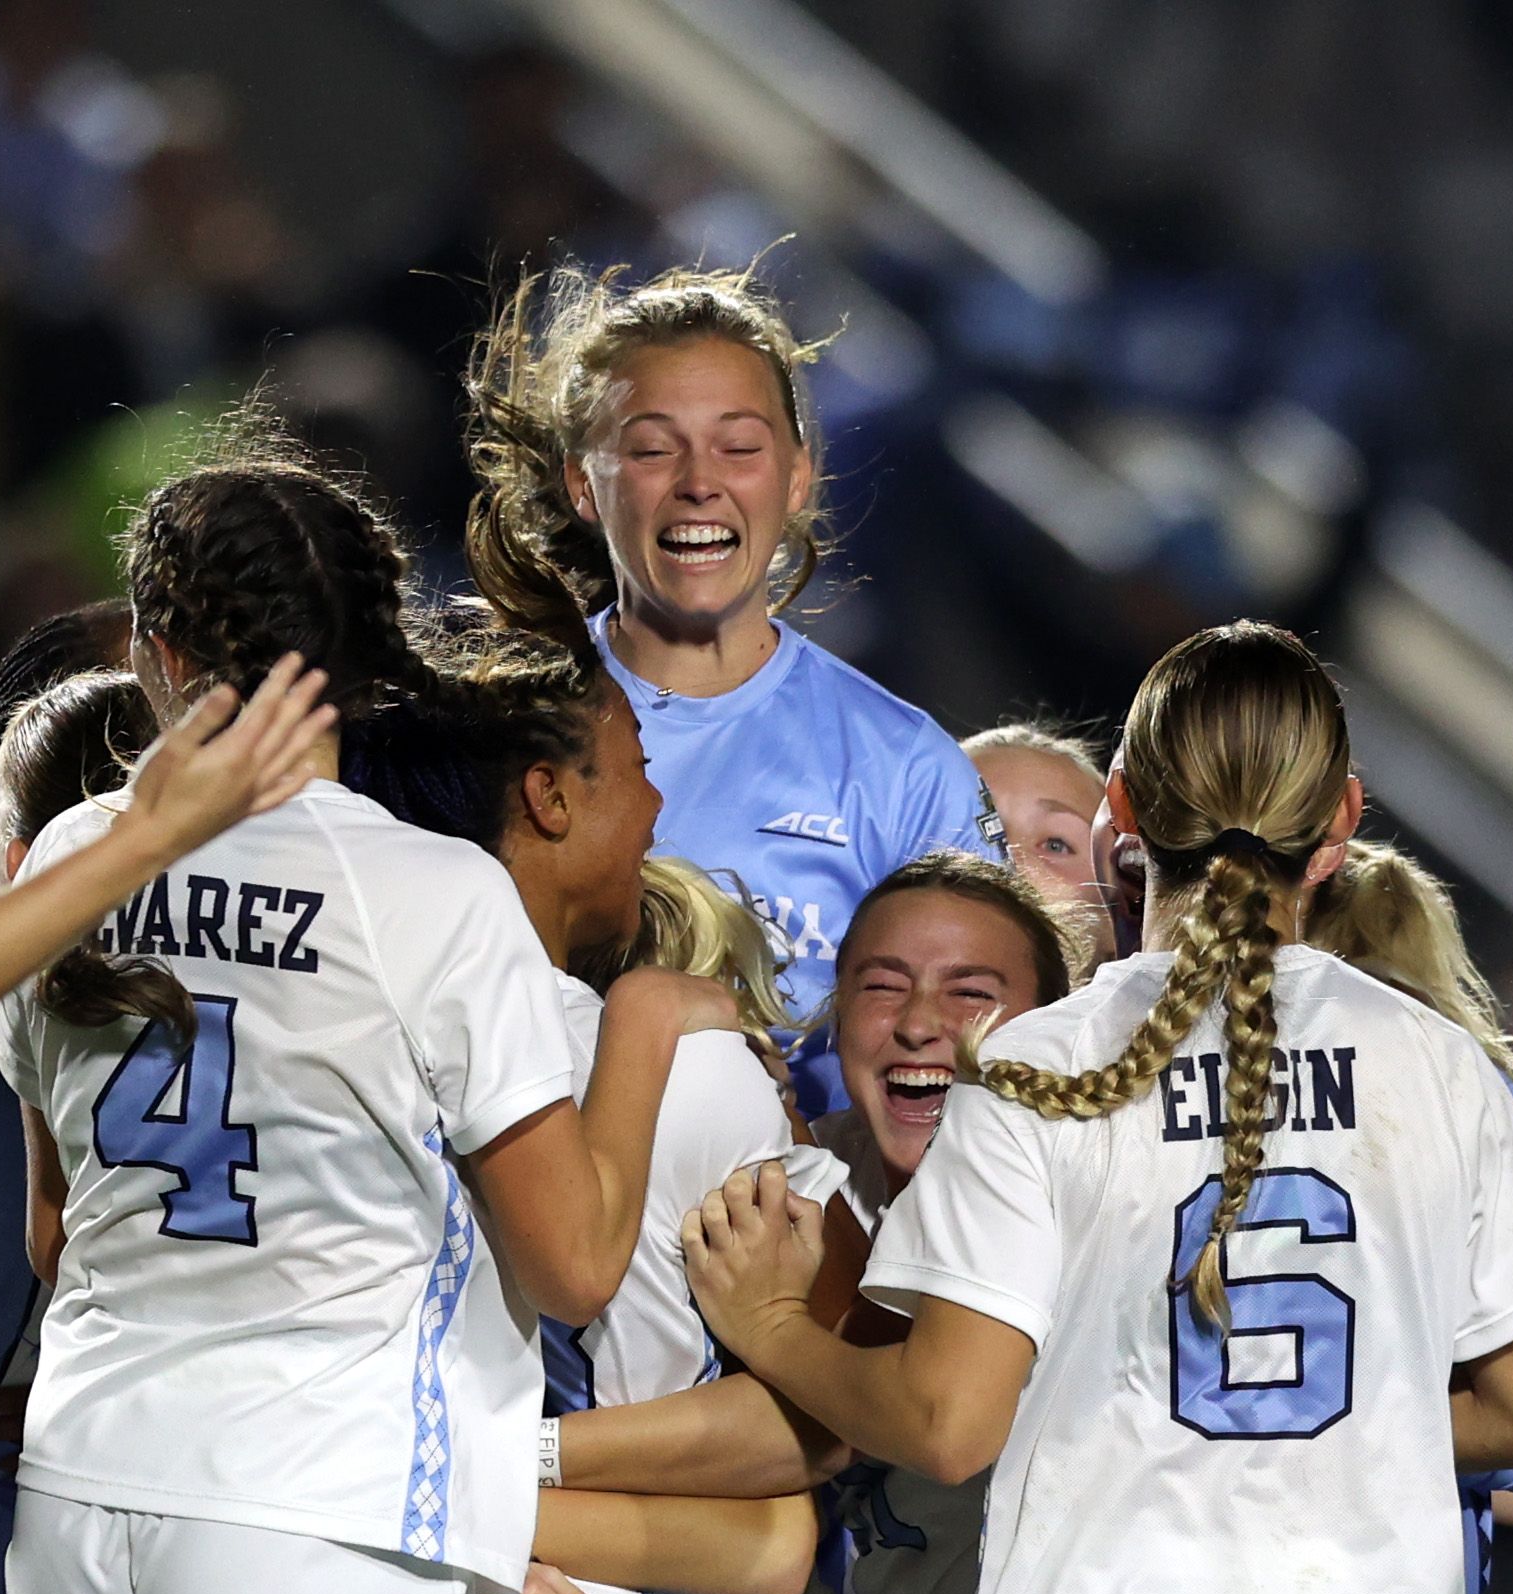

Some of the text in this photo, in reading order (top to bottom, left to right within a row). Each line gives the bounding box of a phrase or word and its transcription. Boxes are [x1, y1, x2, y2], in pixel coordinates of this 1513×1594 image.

[764, 811, 849, 844] ACC
[100, 866, 325, 974] VAREZ
[91, 993, 259, 1248] 4
[1169, 1167, 1357, 1441] 6
